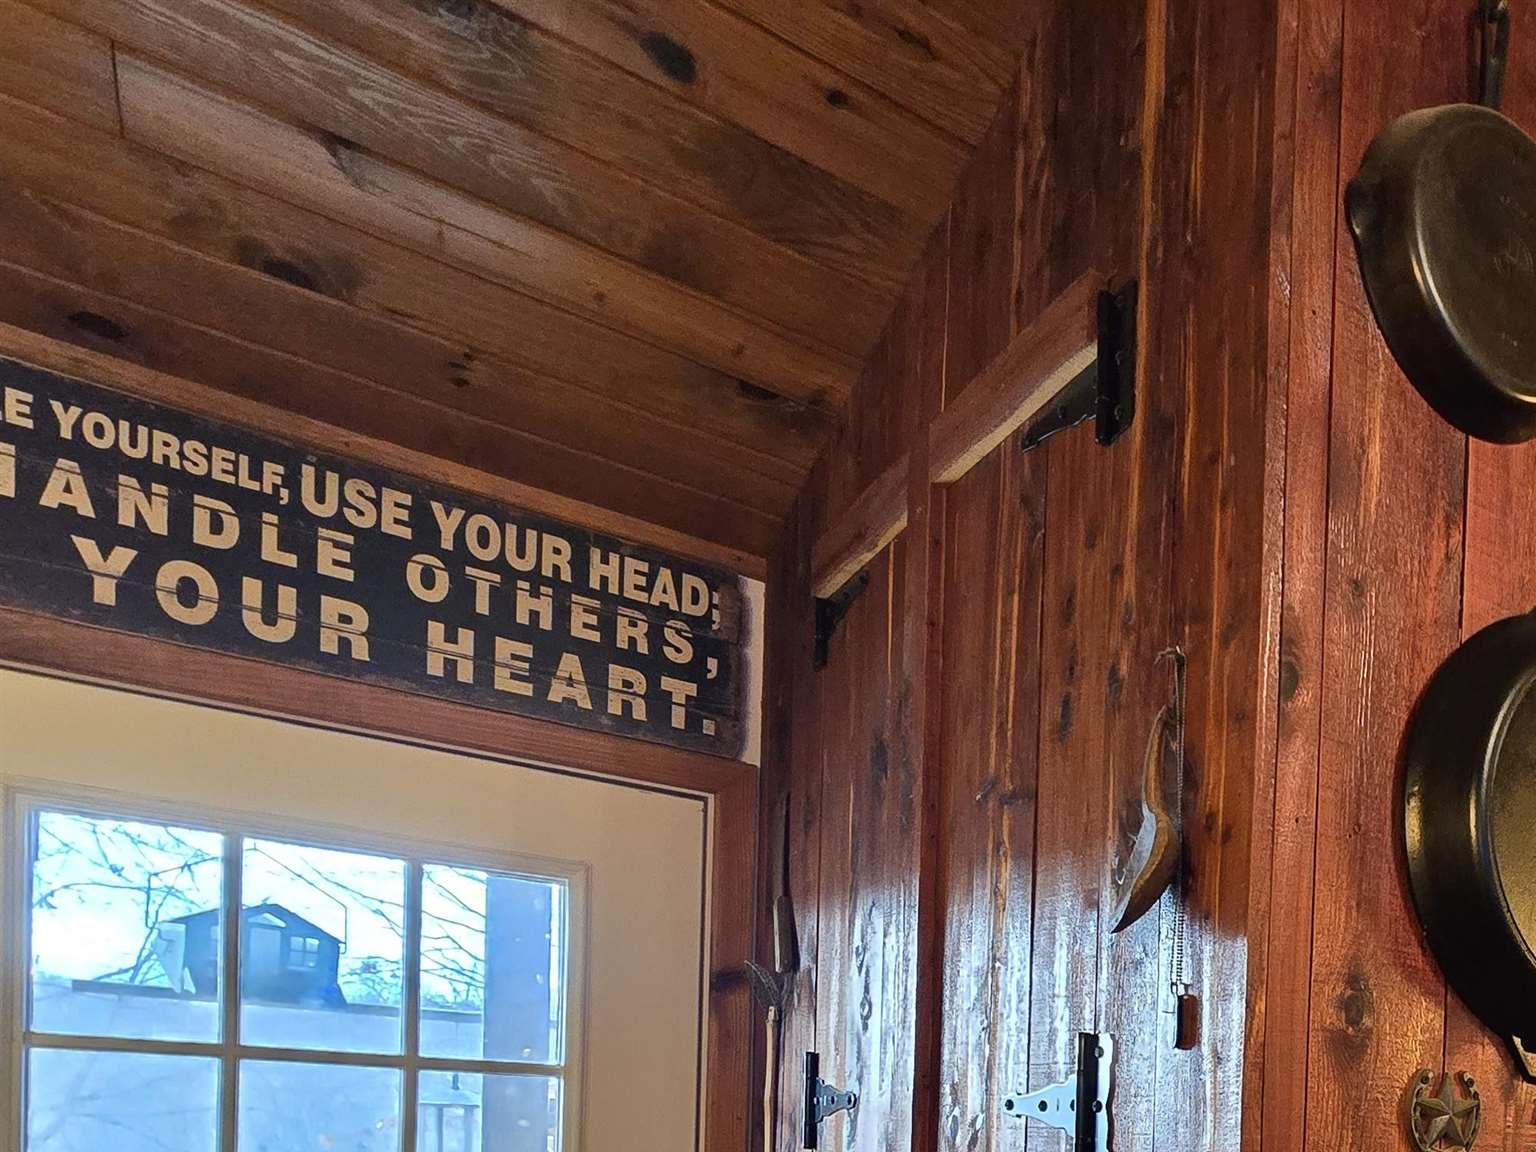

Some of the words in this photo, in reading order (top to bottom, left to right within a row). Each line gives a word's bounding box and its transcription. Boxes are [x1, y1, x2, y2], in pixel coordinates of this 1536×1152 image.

[0, 387, 34, 430] E
[49, 399, 290, 505] YOURSELF,
[301, 464, 412, 540] USE
[431, 501, 572, 583] YOUR
[588, 546, 721, 630] HEAD;
[70, 534, 371, 662] YOUR
[426, 619, 716, 737] HEART.
[406, 553, 719, 680] OTHERS,
